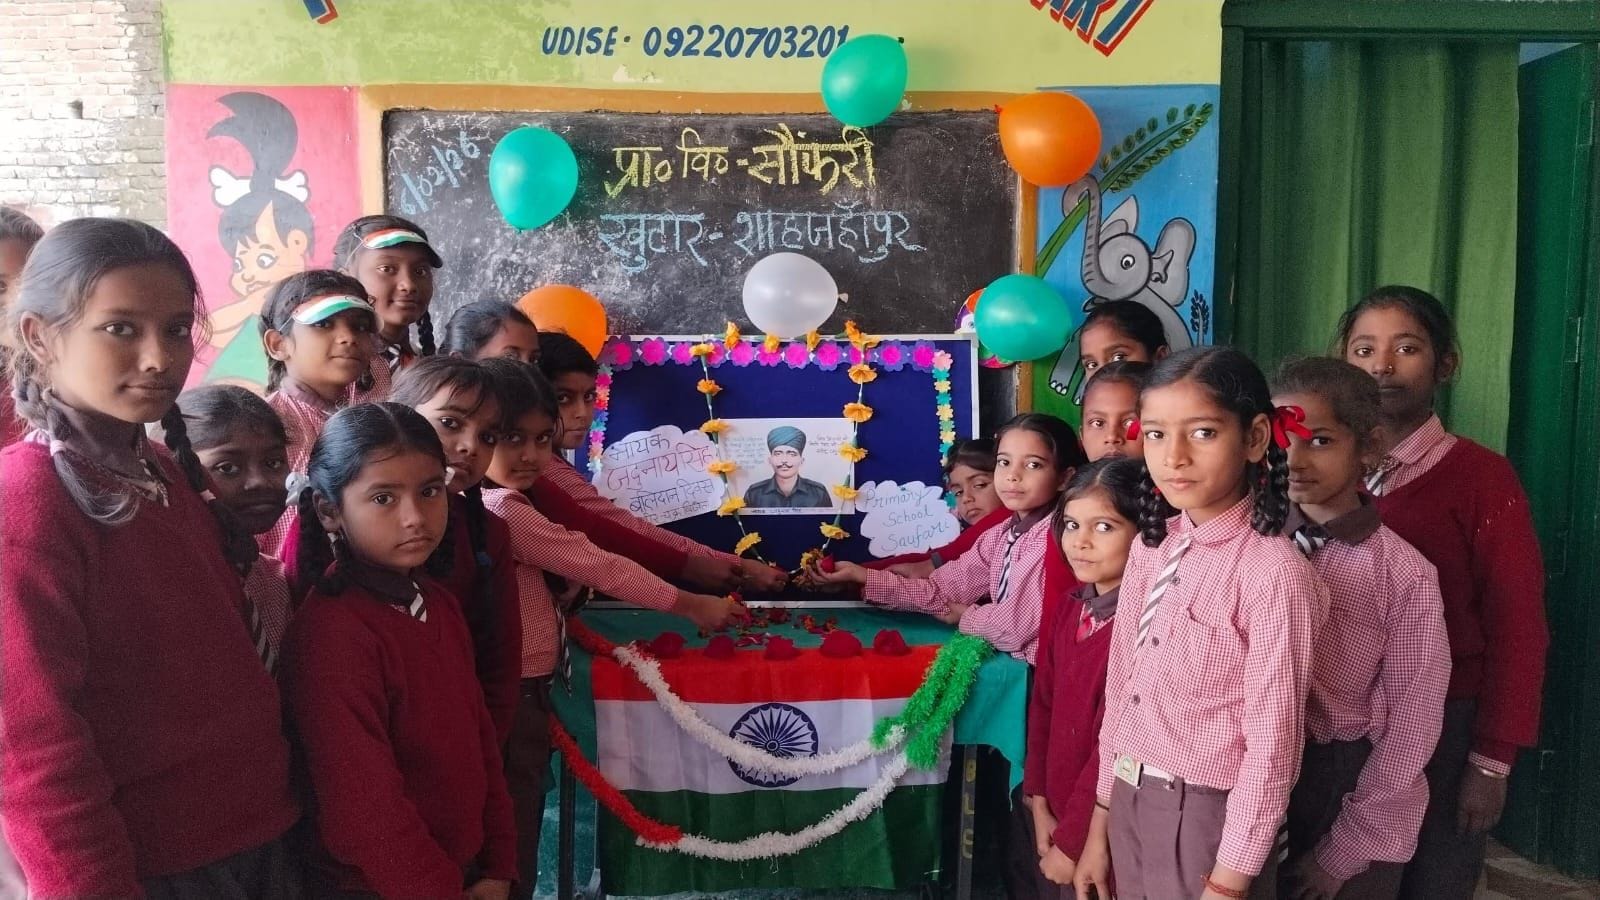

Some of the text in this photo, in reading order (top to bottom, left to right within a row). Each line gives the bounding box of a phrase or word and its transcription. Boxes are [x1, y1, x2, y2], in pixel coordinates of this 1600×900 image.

[643, 24, 850, 58] 09220703201
[609, 433, 670, 461] नायक
[865, 487, 933, 508] Primary
[883, 504, 933, 527] School
[881, 519, 949, 551] Saufari
